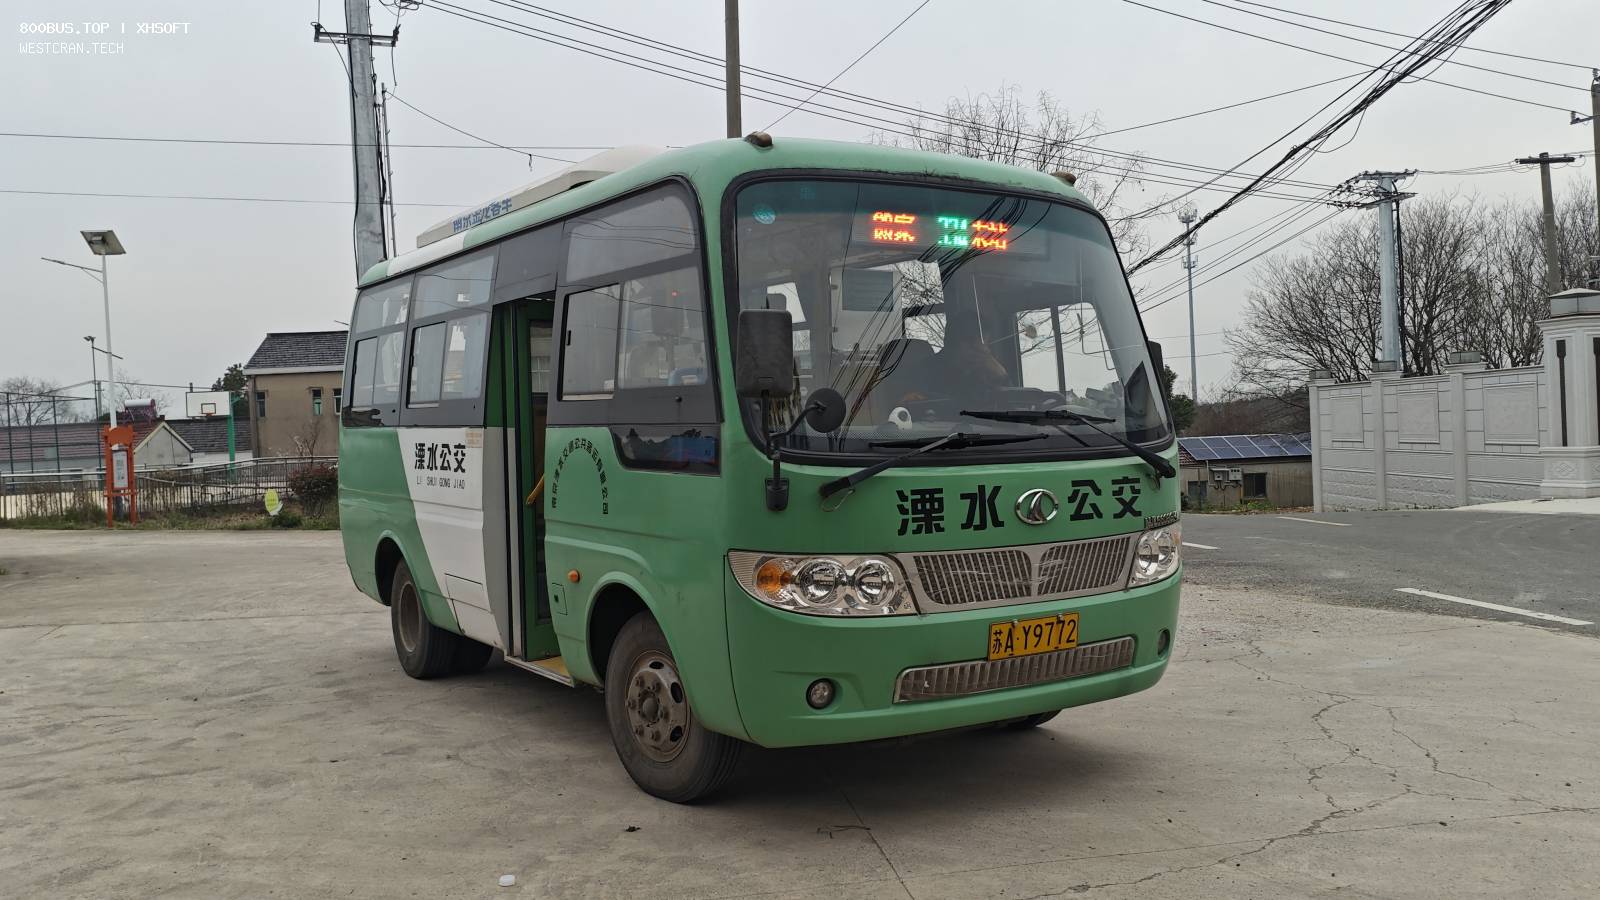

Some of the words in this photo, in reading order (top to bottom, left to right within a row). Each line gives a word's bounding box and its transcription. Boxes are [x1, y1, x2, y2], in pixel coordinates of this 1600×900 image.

[415, 443, 466, 473] 溧水公交
[895, 484, 1005, 537] 溧水
[1067, 476, 1143, 522] 公交
